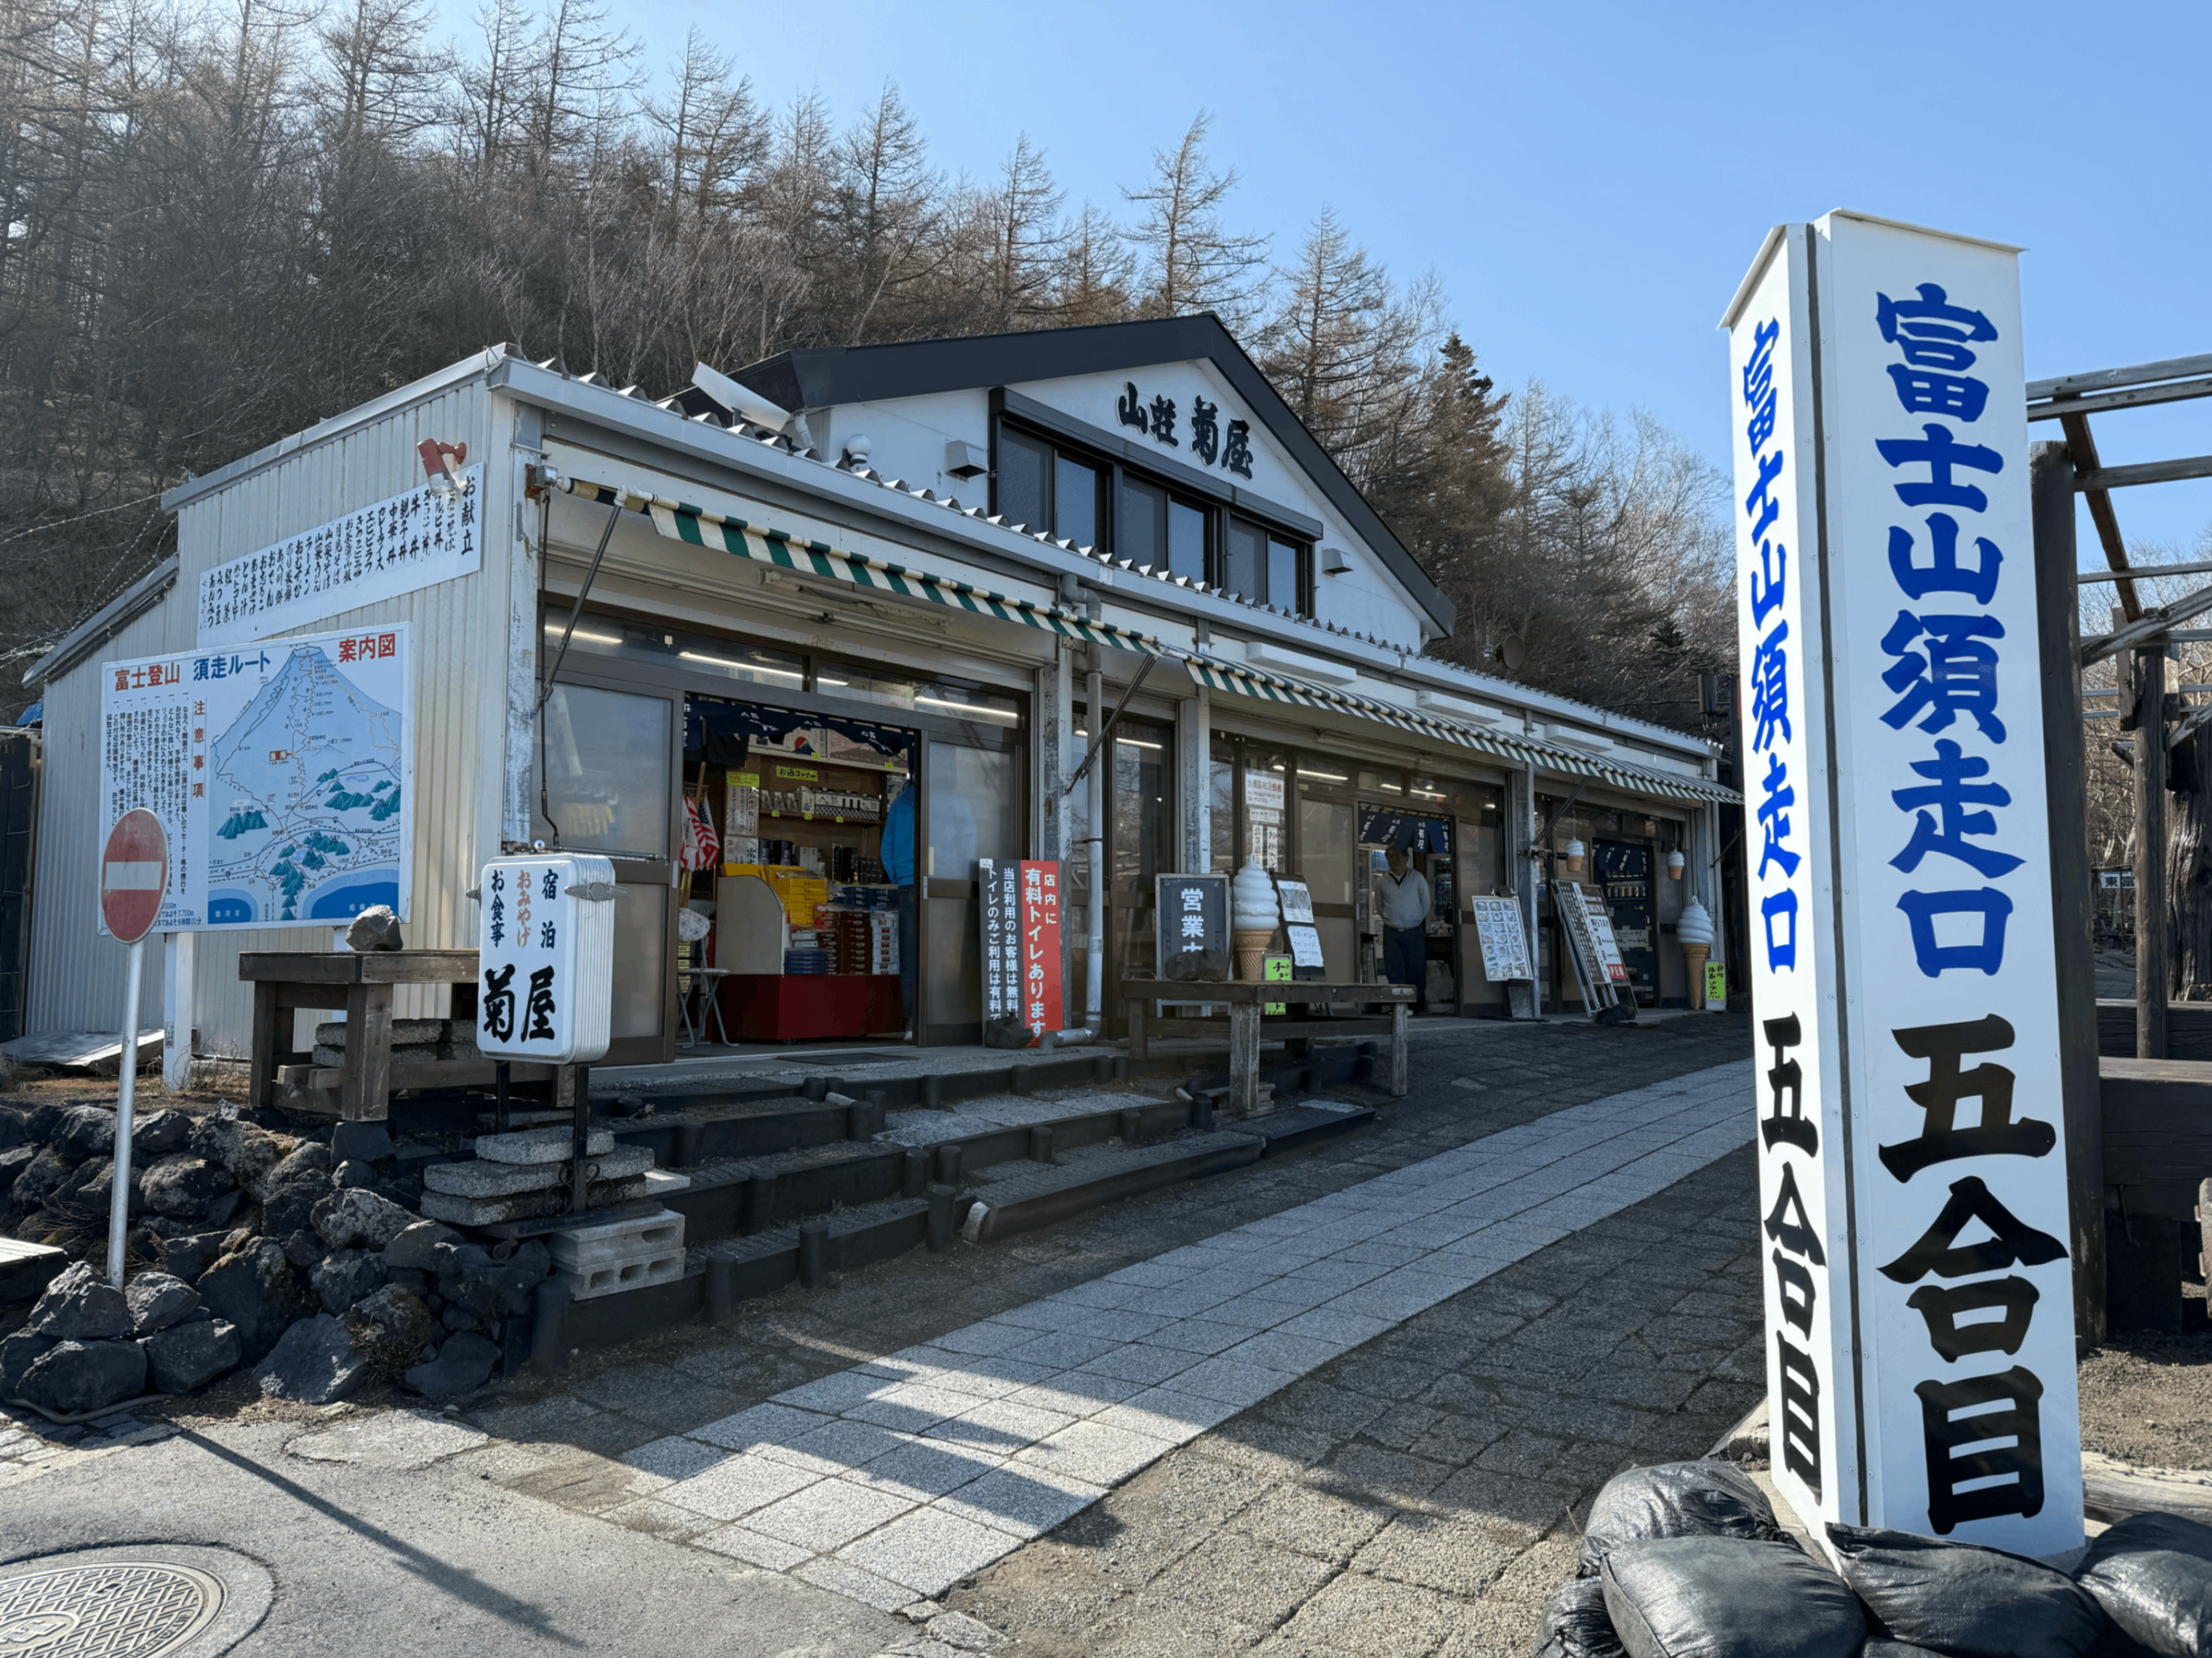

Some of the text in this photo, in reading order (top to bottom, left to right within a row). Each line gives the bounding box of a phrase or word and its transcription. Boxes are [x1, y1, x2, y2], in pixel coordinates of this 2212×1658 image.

[375, 507, 386, 571] カレーライス
[386, 502, 398, 565] 中華丼
[461, 475, 475, 555] お献立
[304, 536, 313, 595] ラーメン
[115, 662, 181, 691] 富士登山
[192, 651, 271, 682] 須走ルート
[339, 633, 396, 663] 案内図
[193, 700, 205, 798] 注意事項
[779, 767, 817, 779] お酒コーナー
[490, 869, 505, 948] お食事
[517, 869, 531, 948] おみやげ
[540, 868, 559, 949] 宿泊
[1044, 874, 1057, 924] 店内に
[1003, 868, 1019, 1019] 当店利用のお客様は無料
[1025, 868, 1045, 1038] 有料トイレあります
[483, 963, 555, 1043] 菊屋
